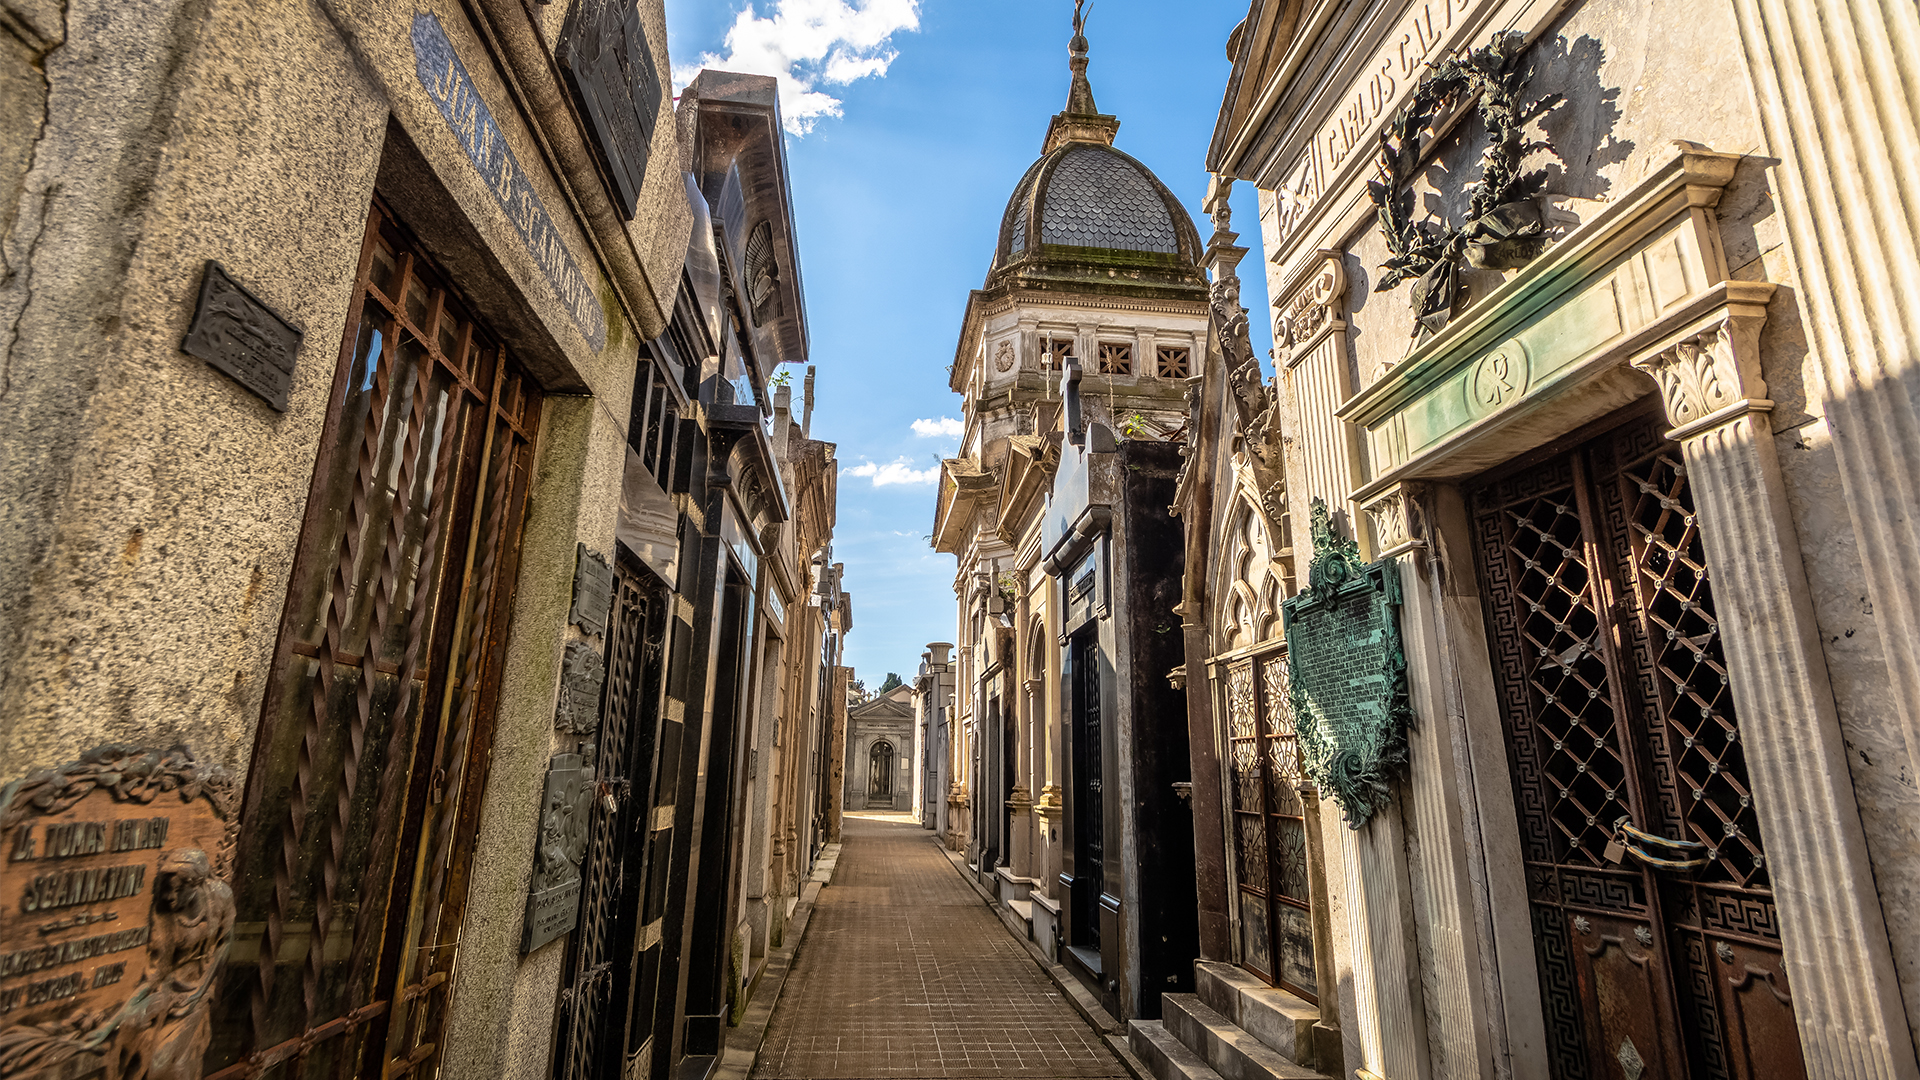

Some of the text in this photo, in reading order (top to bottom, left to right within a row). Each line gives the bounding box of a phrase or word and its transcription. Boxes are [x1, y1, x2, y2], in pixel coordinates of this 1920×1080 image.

[1328, 57, 1396, 170] CARLOS
[45, 821, 108, 859] TOMAS
[110, 817, 170, 853] IGNACIO
[21, 864, 147, 912] SCANNAVINO
